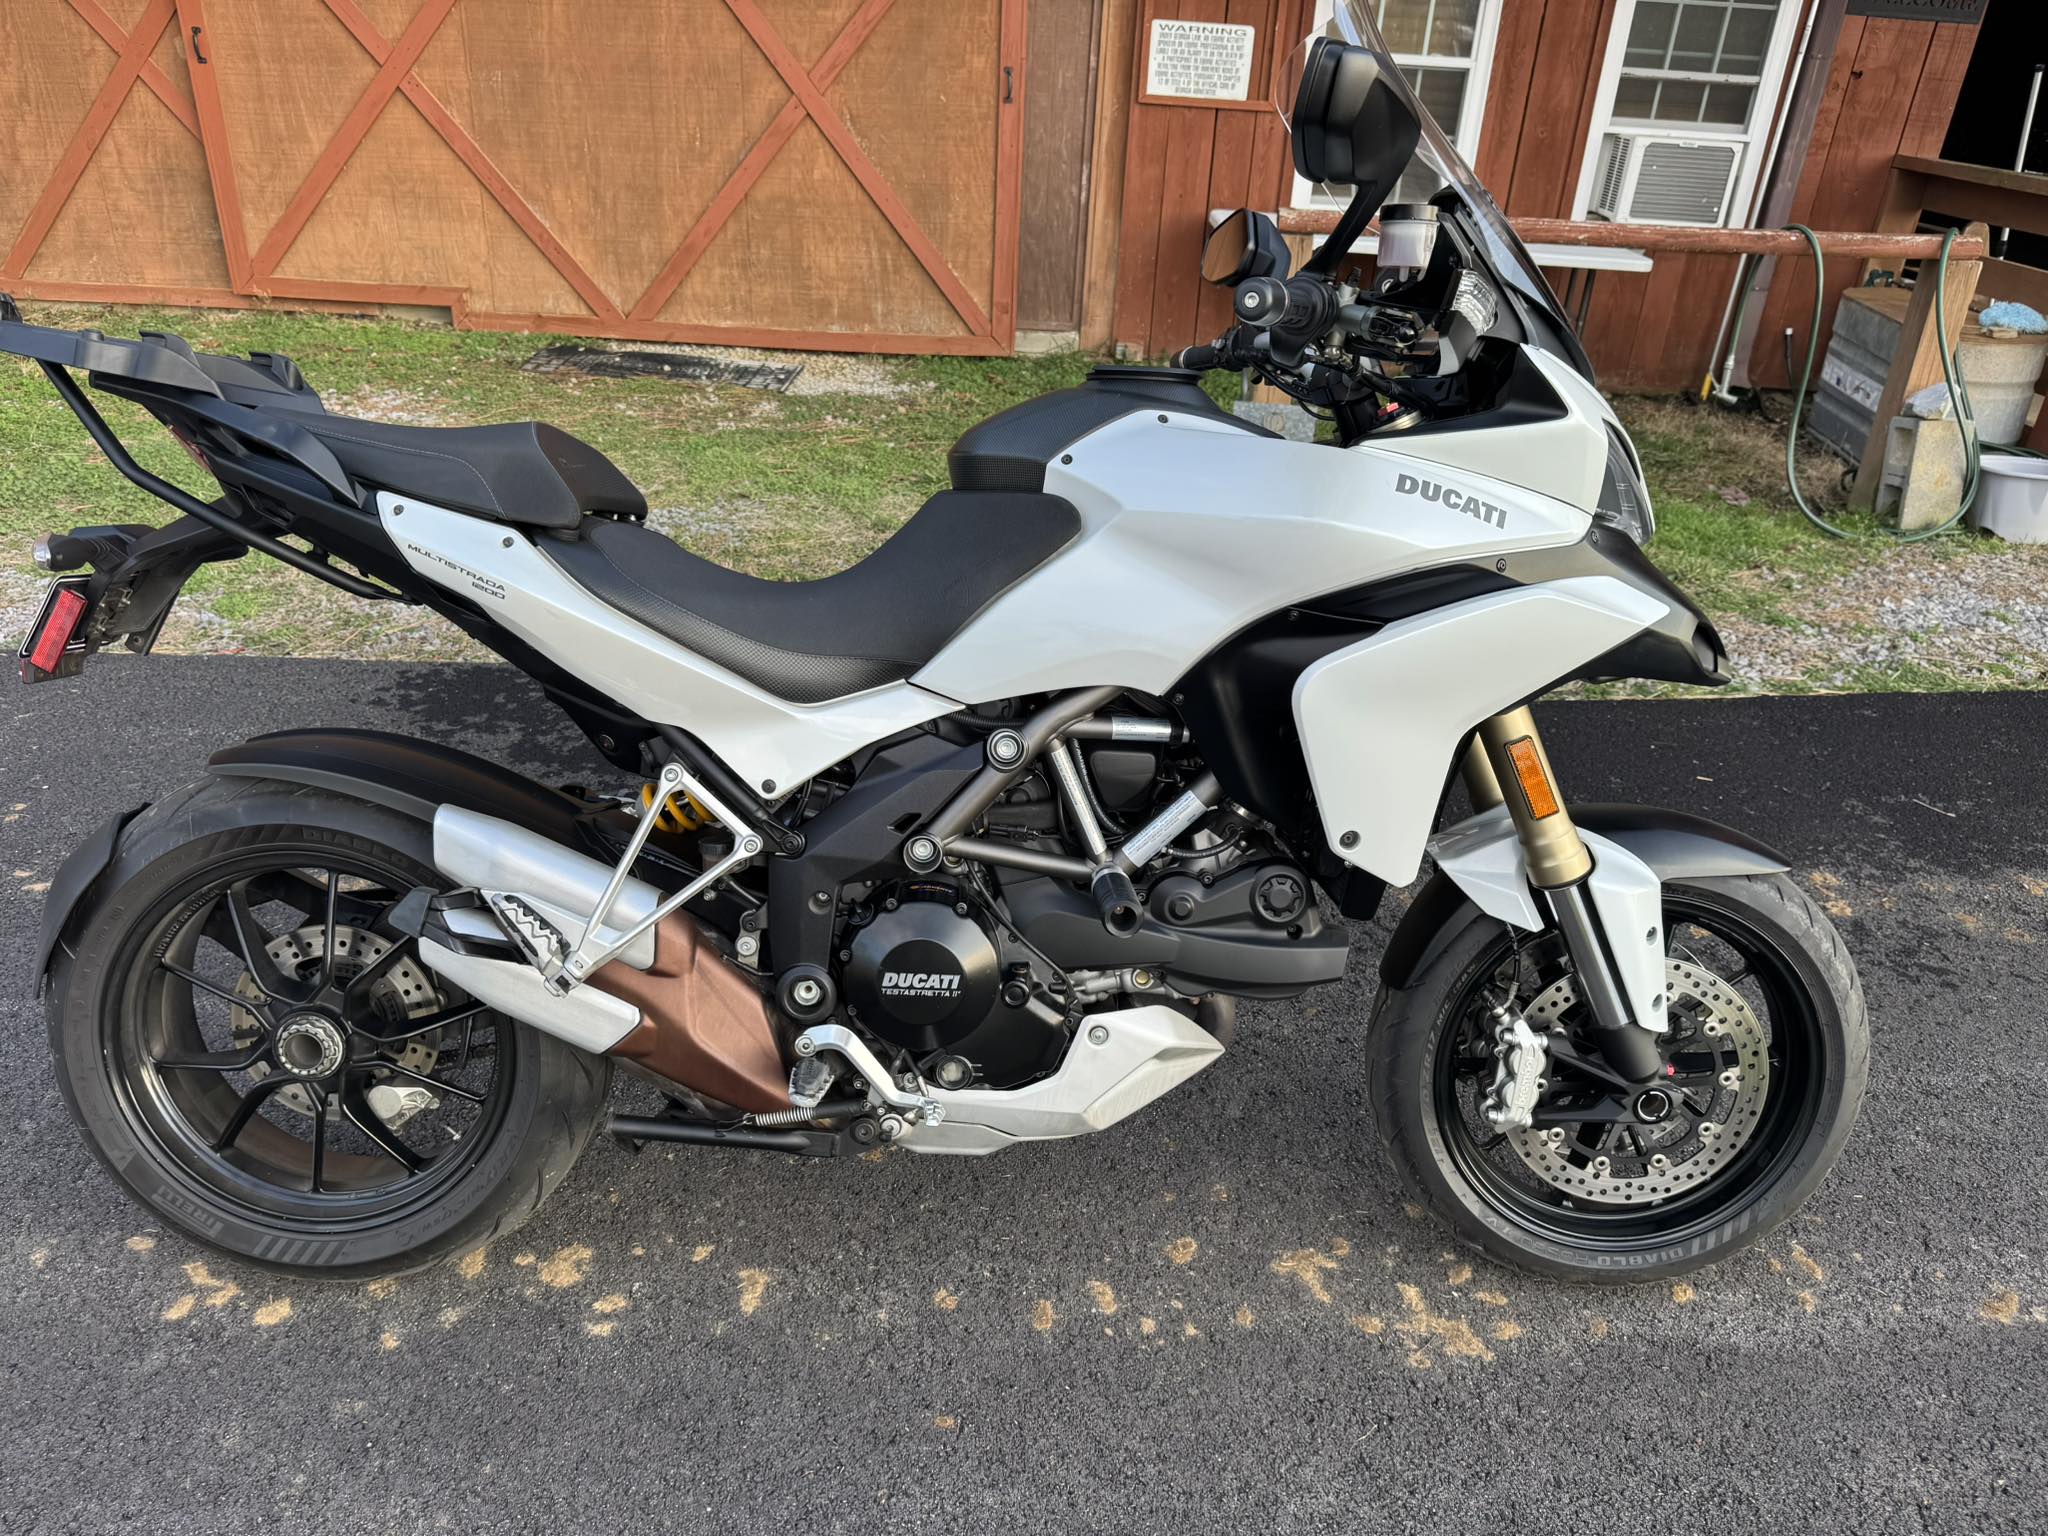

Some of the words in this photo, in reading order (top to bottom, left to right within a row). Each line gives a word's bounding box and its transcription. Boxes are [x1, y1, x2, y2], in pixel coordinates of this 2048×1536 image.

[1159, 23, 1247, 37] WARNING
[1395, 473, 1507, 529] DUCATI
[407, 543, 505, 592] MULTISTRADA
[471, 581, 505, 600] 1200
[881, 972, 961, 989] DUCATI
[881, 988, 950, 997] TESTASTRETTA
[151, 1185, 224, 1238] PIRELLI
[1597, 1248, 1684, 1266] DIABLO
